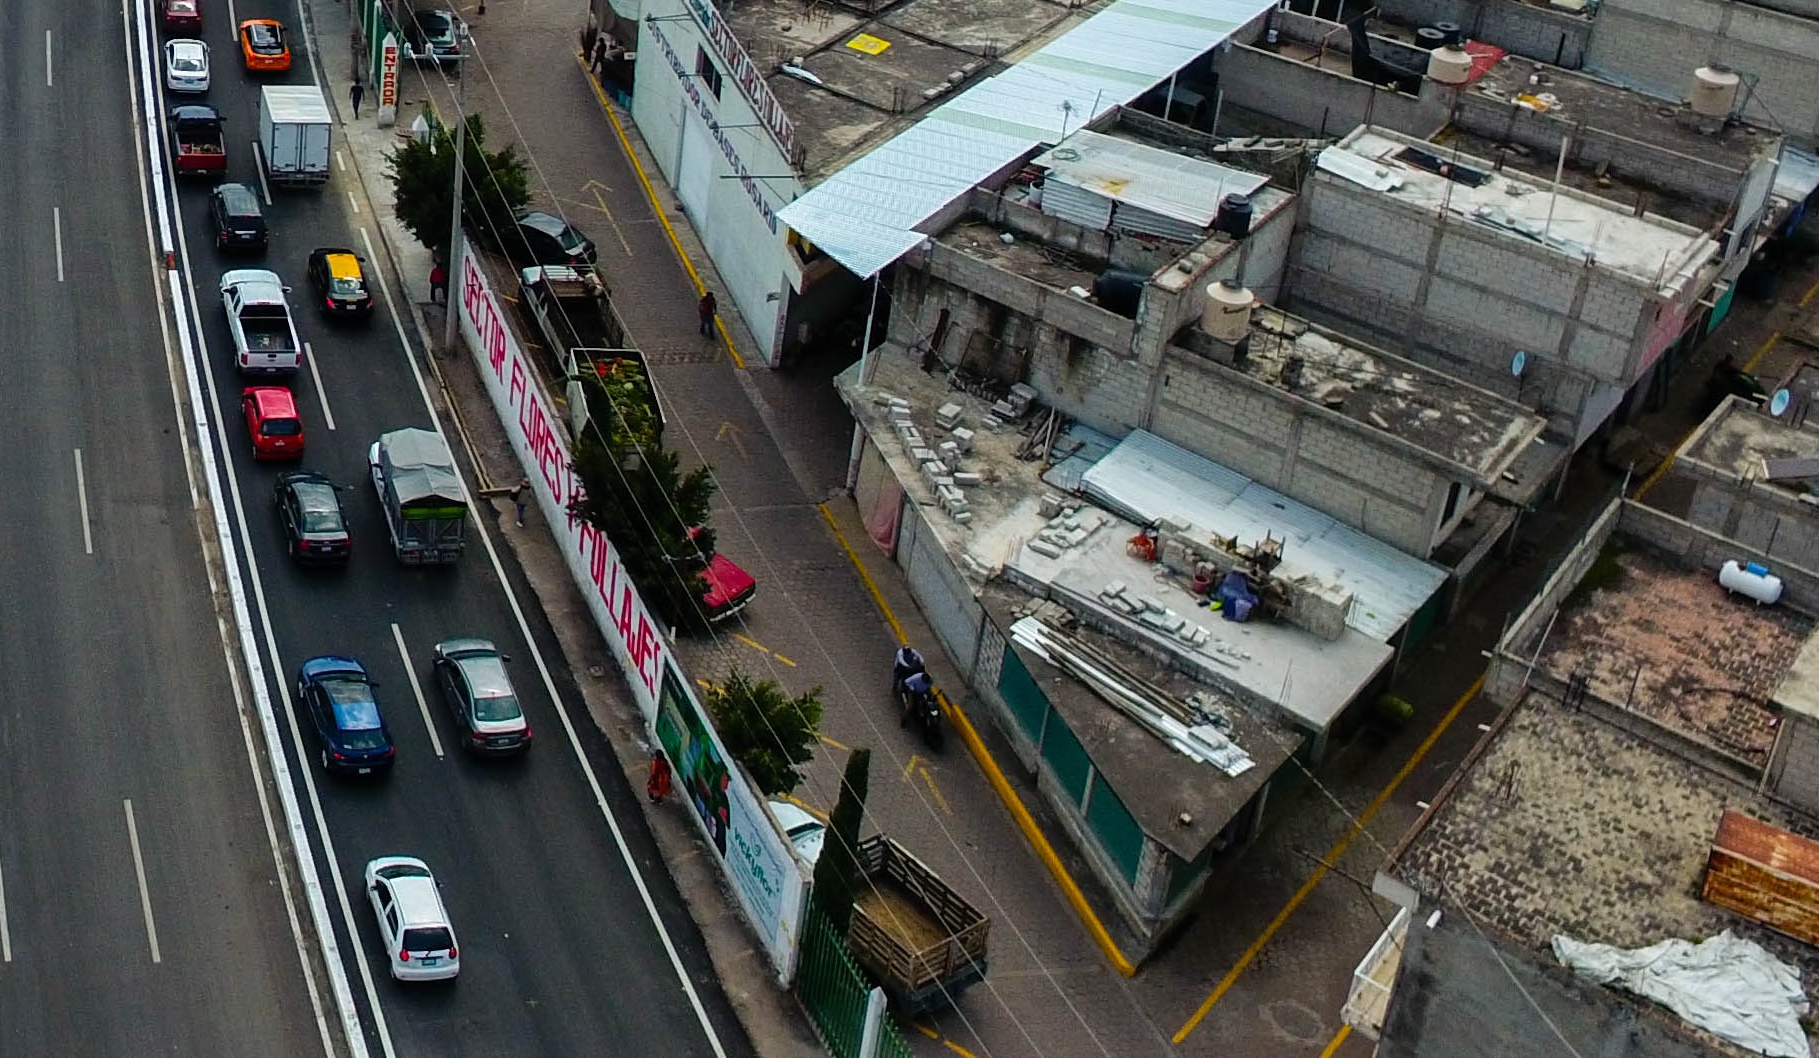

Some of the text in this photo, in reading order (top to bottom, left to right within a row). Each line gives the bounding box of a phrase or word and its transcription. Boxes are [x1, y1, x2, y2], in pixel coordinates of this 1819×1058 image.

[382, 46, 397, 106] ENTRADA
[463, 255, 507, 385] SECTOR
[509, 354, 565, 505] FLORES
[579, 520, 661, 702] FOLLAJES
